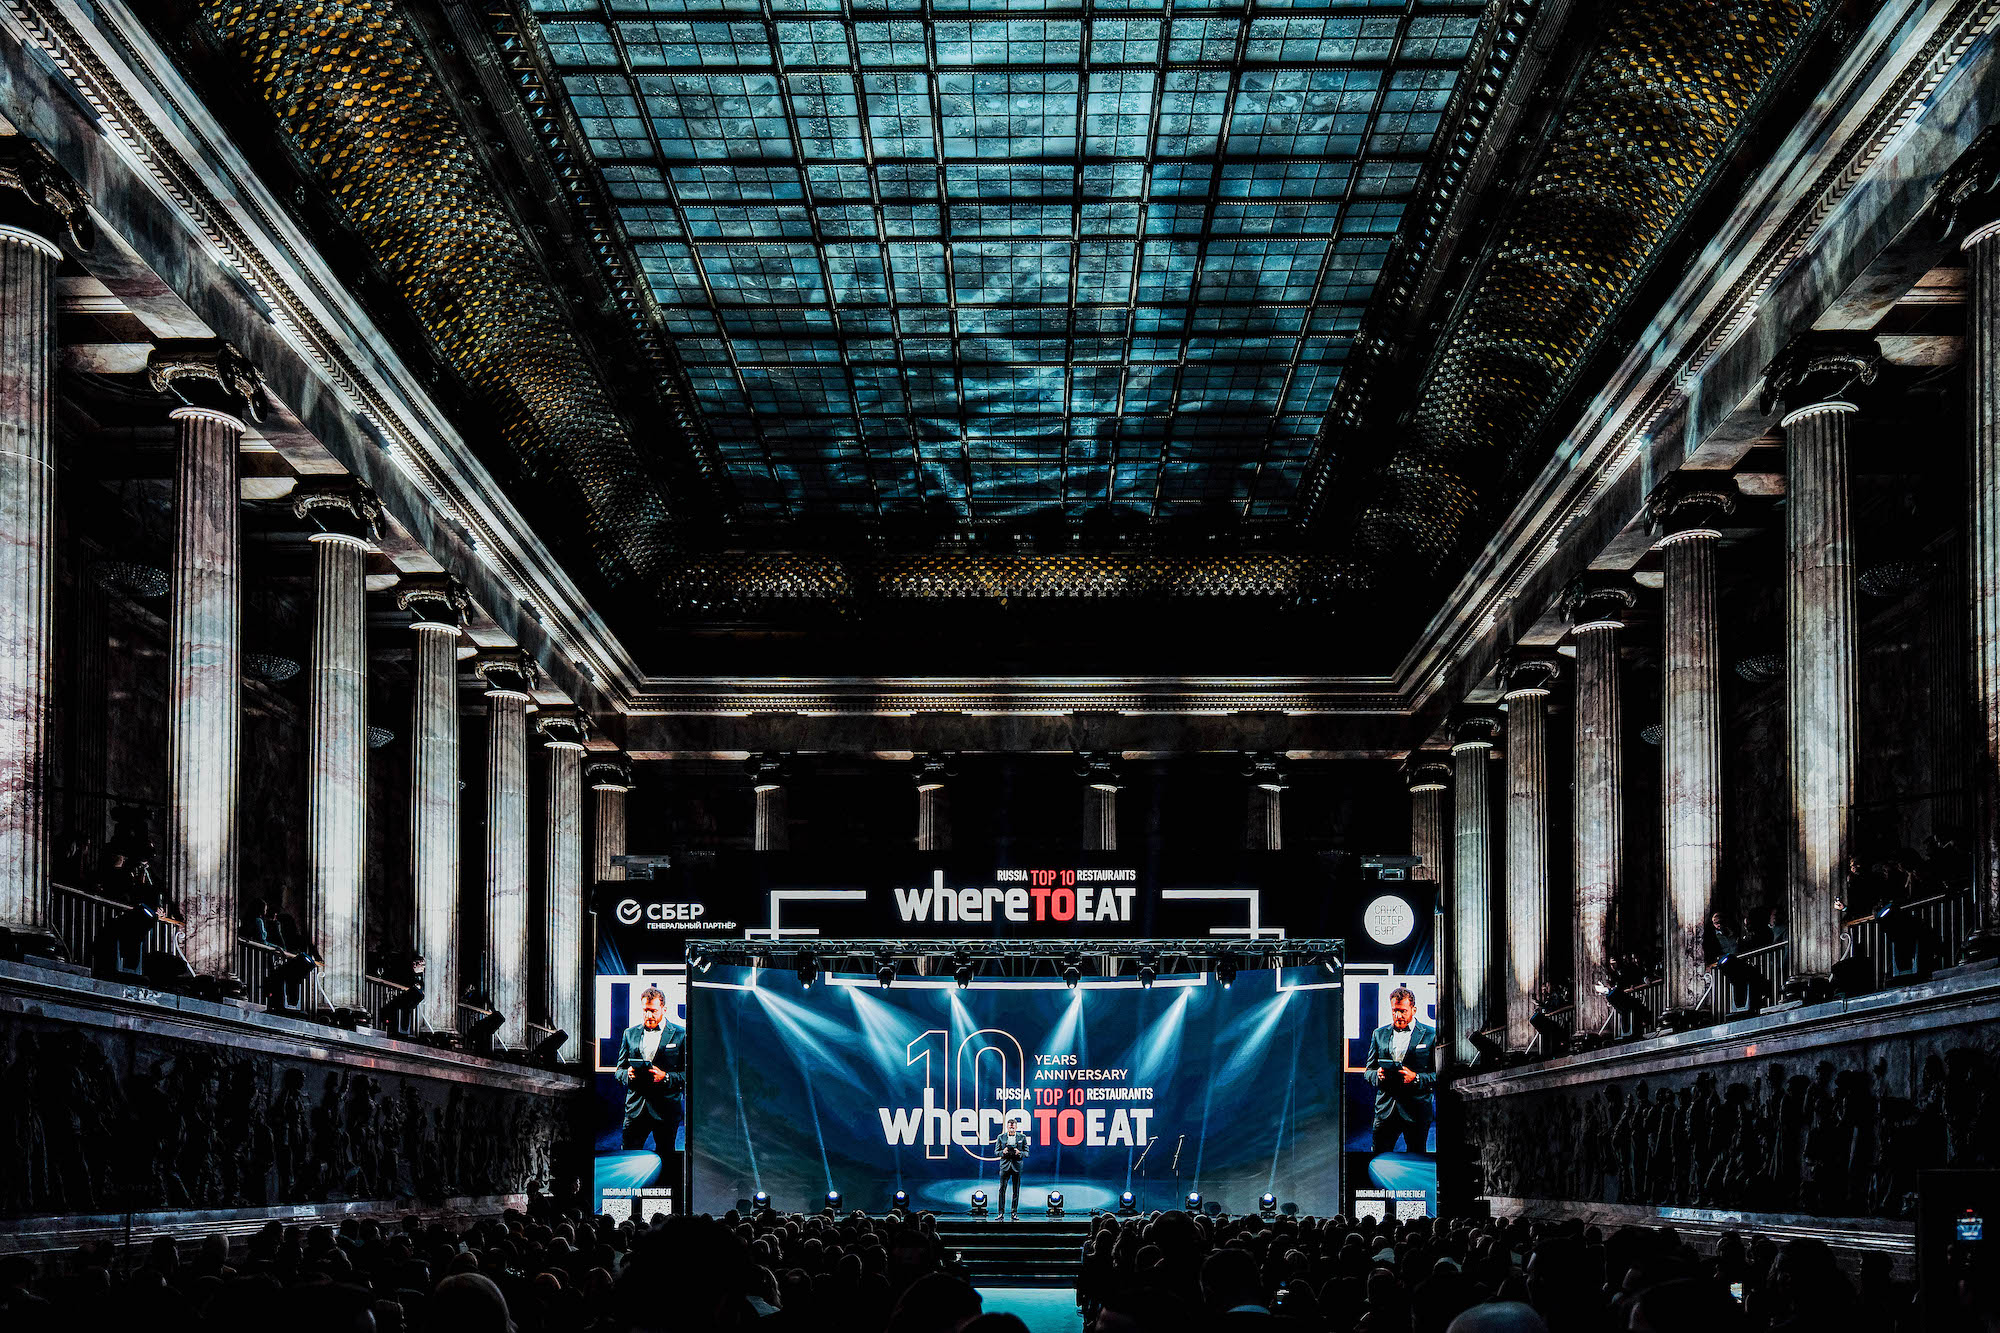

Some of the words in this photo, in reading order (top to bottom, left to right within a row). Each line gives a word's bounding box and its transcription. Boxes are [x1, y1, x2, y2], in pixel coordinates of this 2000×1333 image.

[997, 870, 1028, 881] RUSSIA
[1030, 870, 1056, 886] TOP
[1060, 870, 1075, 886] 10
[1076, 870, 1136, 881] RESTAURANTS
[646, 903, 704, 920] СБЕР
[1374, 904, 1403, 915] САНКТ
[647, 921, 701, 930] ГЕНЕРАЛЬНЫЙ
[702, 921, 737, 930] ПАРТНЁР
[1374, 915, 1404, 925] ПЕТЕР
[1374, 926, 1397, 936] БУРГ
[1034, 1054, 1077, 1066] YEARS
[1034, 1068, 1128, 1081] ANNIVERSARY
[996, 1087, 1031, 1101] RUSSIA
[1034, 1087, 1063, 1106] TOP
[1066, 1087, 1084, 1106] 10
[1086, 1087, 1154, 1101] RESTAURANTS
